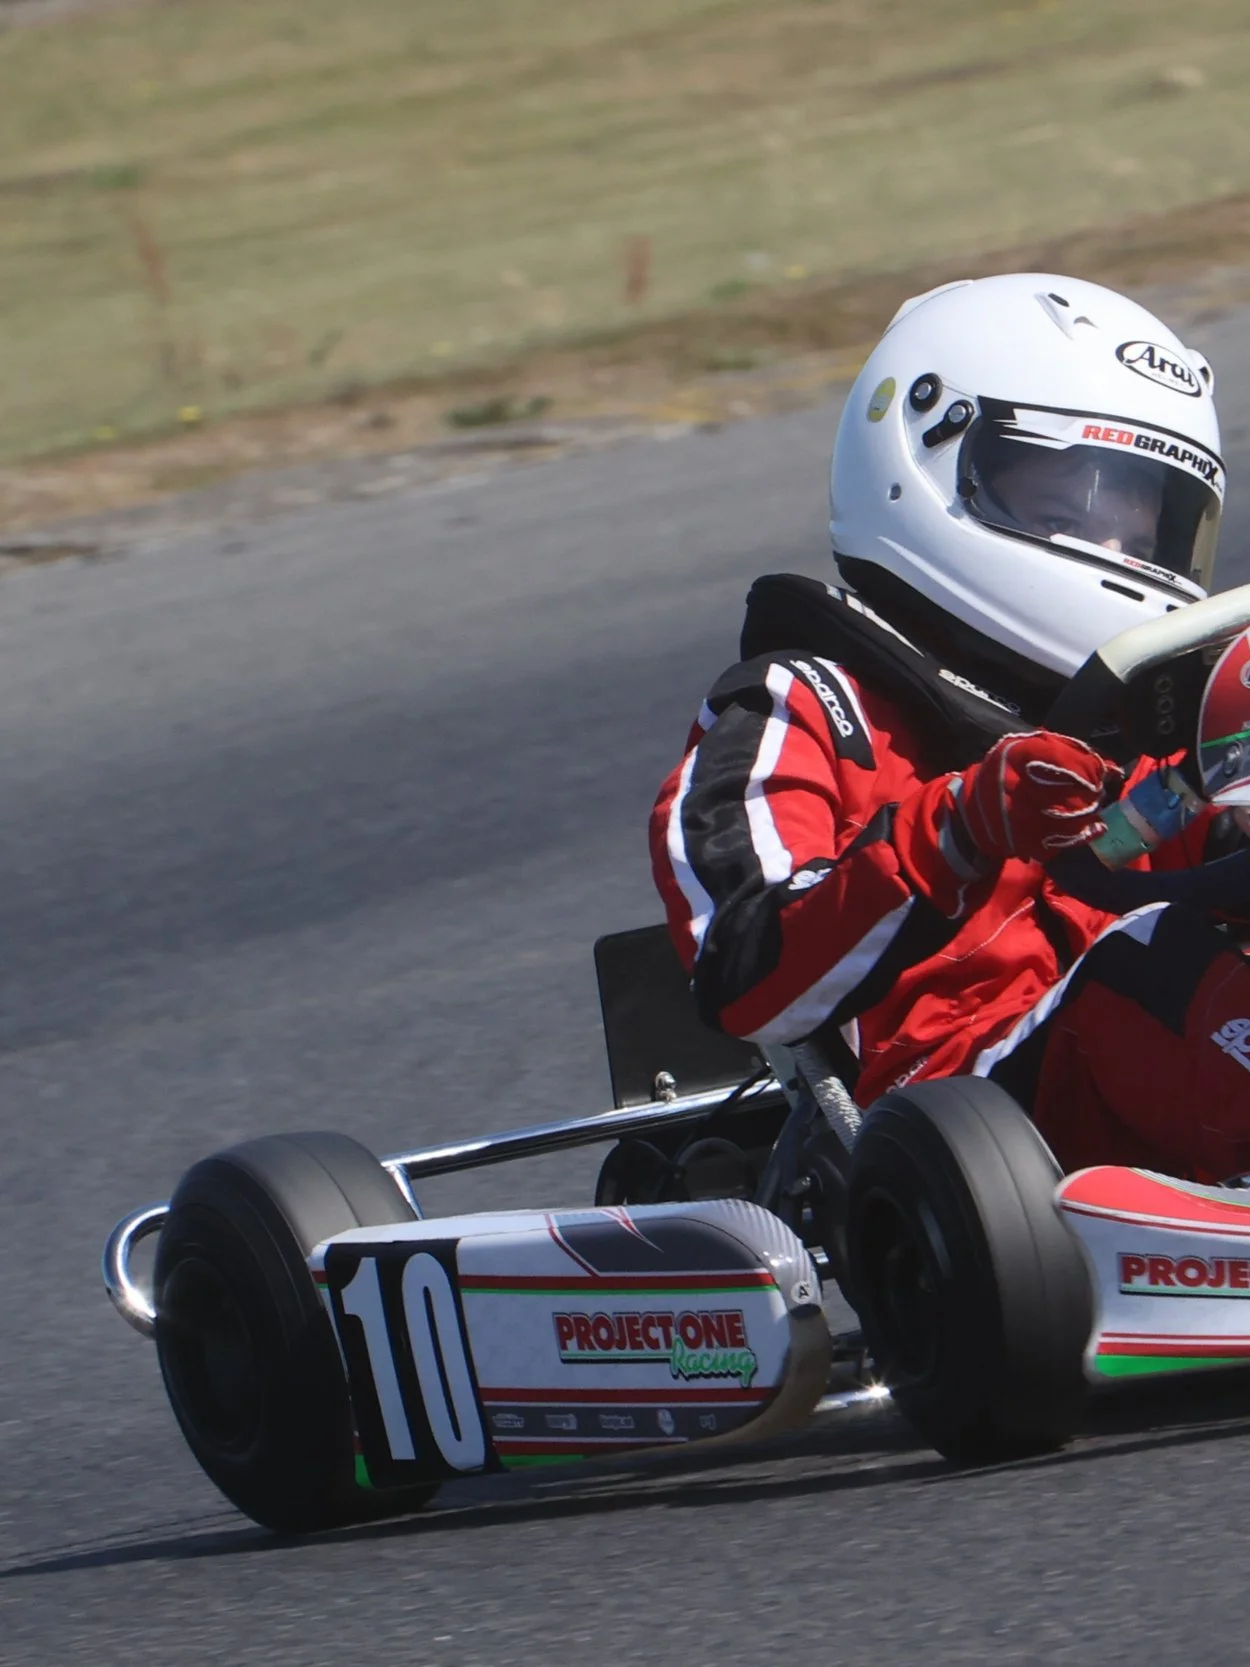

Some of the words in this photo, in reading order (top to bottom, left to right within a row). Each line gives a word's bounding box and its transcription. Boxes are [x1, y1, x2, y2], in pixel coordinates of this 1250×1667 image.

[789, 659, 854, 738] sparco
[340, 1252, 487, 1472] 10
[554, 1314, 674, 1351] PROJECT
[677, 1312, 745, 1349] ONE
[671, 1335, 757, 1387] Racing
